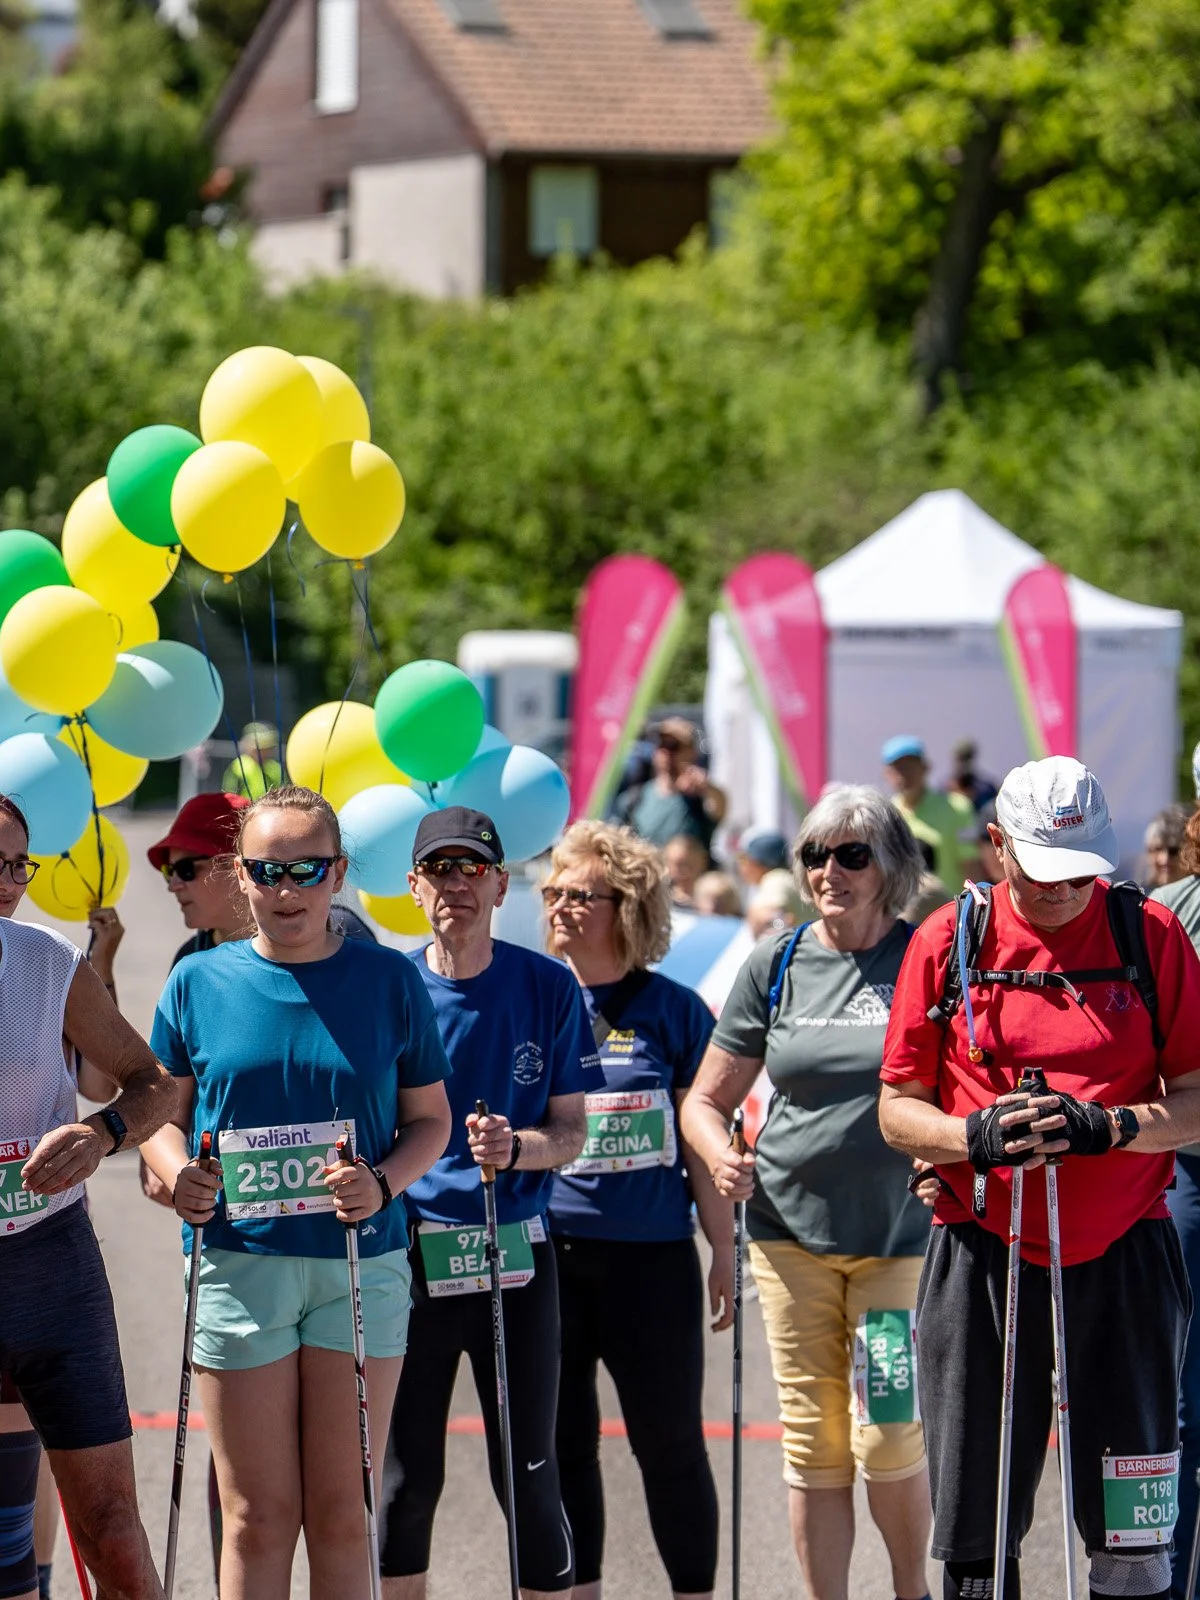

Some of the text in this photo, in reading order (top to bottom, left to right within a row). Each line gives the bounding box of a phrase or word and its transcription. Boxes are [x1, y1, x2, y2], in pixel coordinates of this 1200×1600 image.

[1053, 815, 1084, 828] USTER
[795, 1017, 827, 1027] GRAND
[829, 1018, 850, 1027] PRIX
[851, 1018, 871, 1027] VON
[597, 1116, 632, 1132] 439
[246, 1128, 312, 1149] valiant
[584, 1133, 652, 1156] EGINA
[237, 1155, 326, 1193] 2502
[1008, 1273, 1016, 1334] WALKER
[870, 1337, 888, 1397] RUTH
[356, 1373, 371, 1468] FLASH
[1139, 1480, 1172, 1500] 1198
[1133, 1502, 1174, 1525] ROLF
